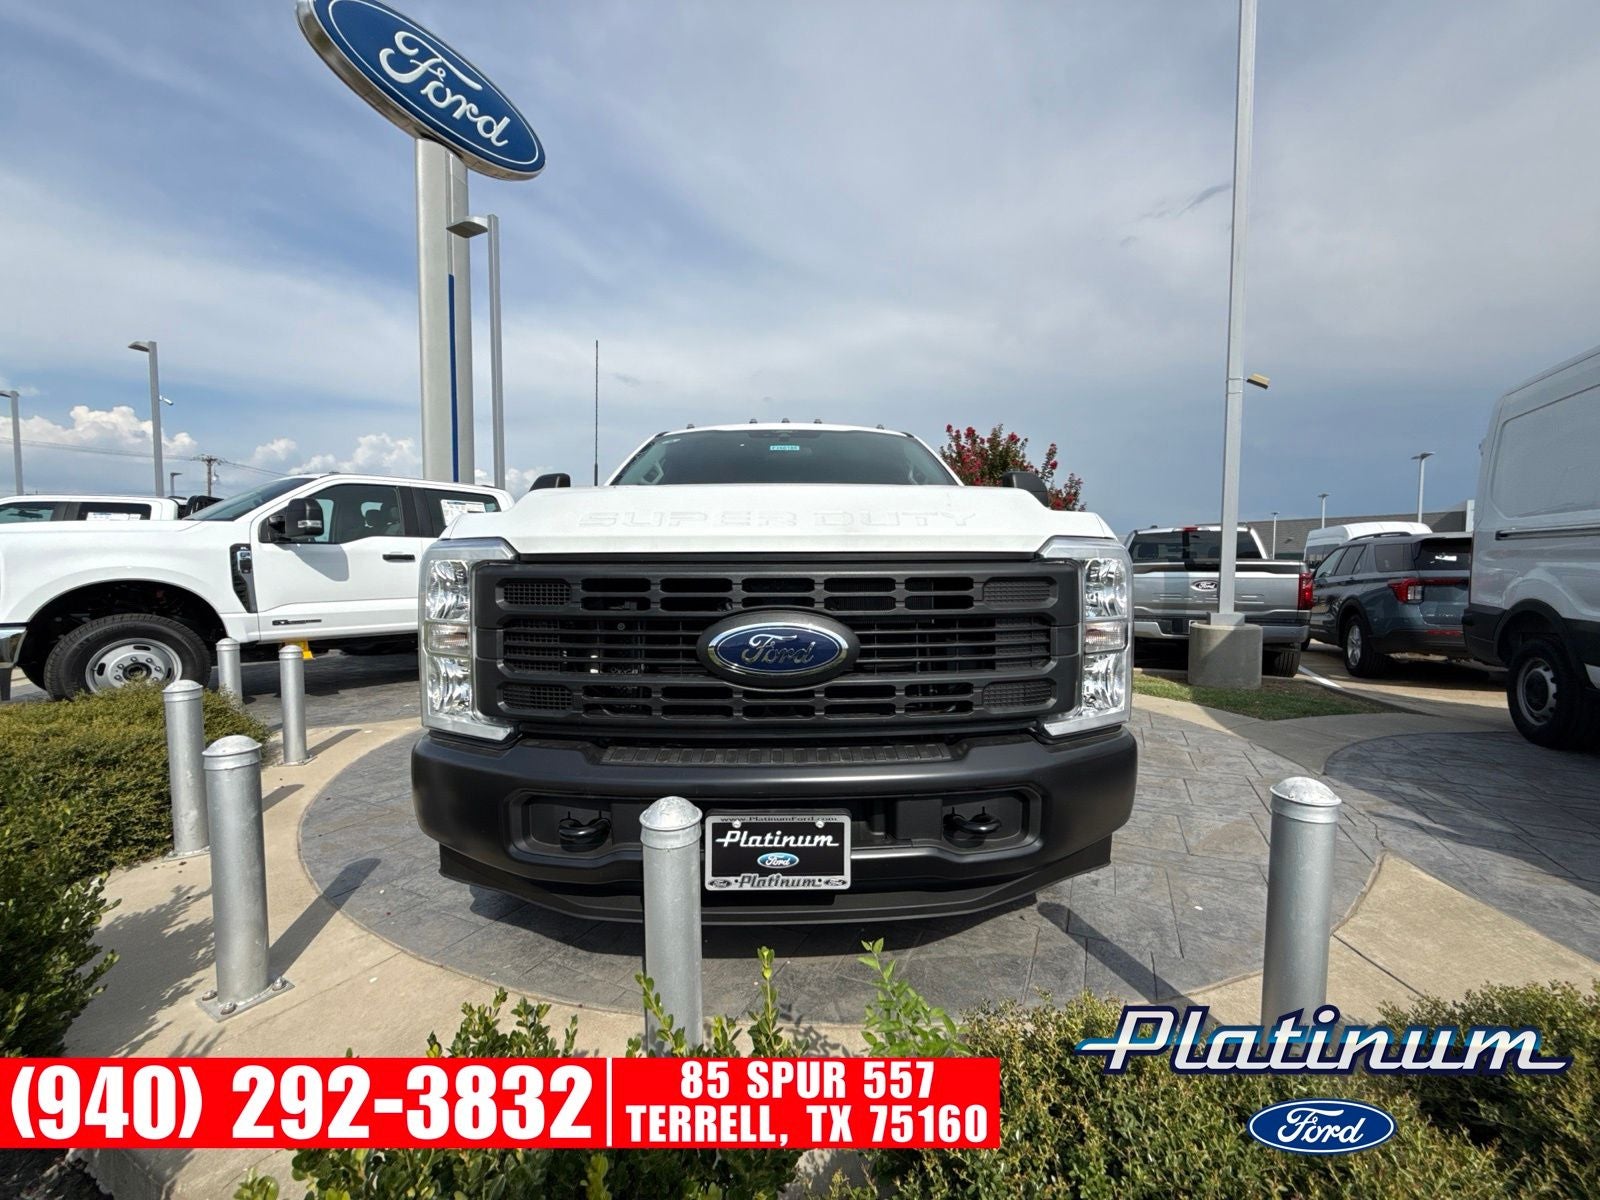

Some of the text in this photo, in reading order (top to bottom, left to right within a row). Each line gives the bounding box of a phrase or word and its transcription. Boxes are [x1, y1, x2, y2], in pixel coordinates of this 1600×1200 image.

[379, 31, 511, 147] Ford
[577, 511, 977, 528] SUPER DUTY
[740, 633, 816, 665] Ford
[715, 830, 839, 847] Platinum
[765, 855, 792, 867] Ford
[738, 874, 822, 888] Platinum
